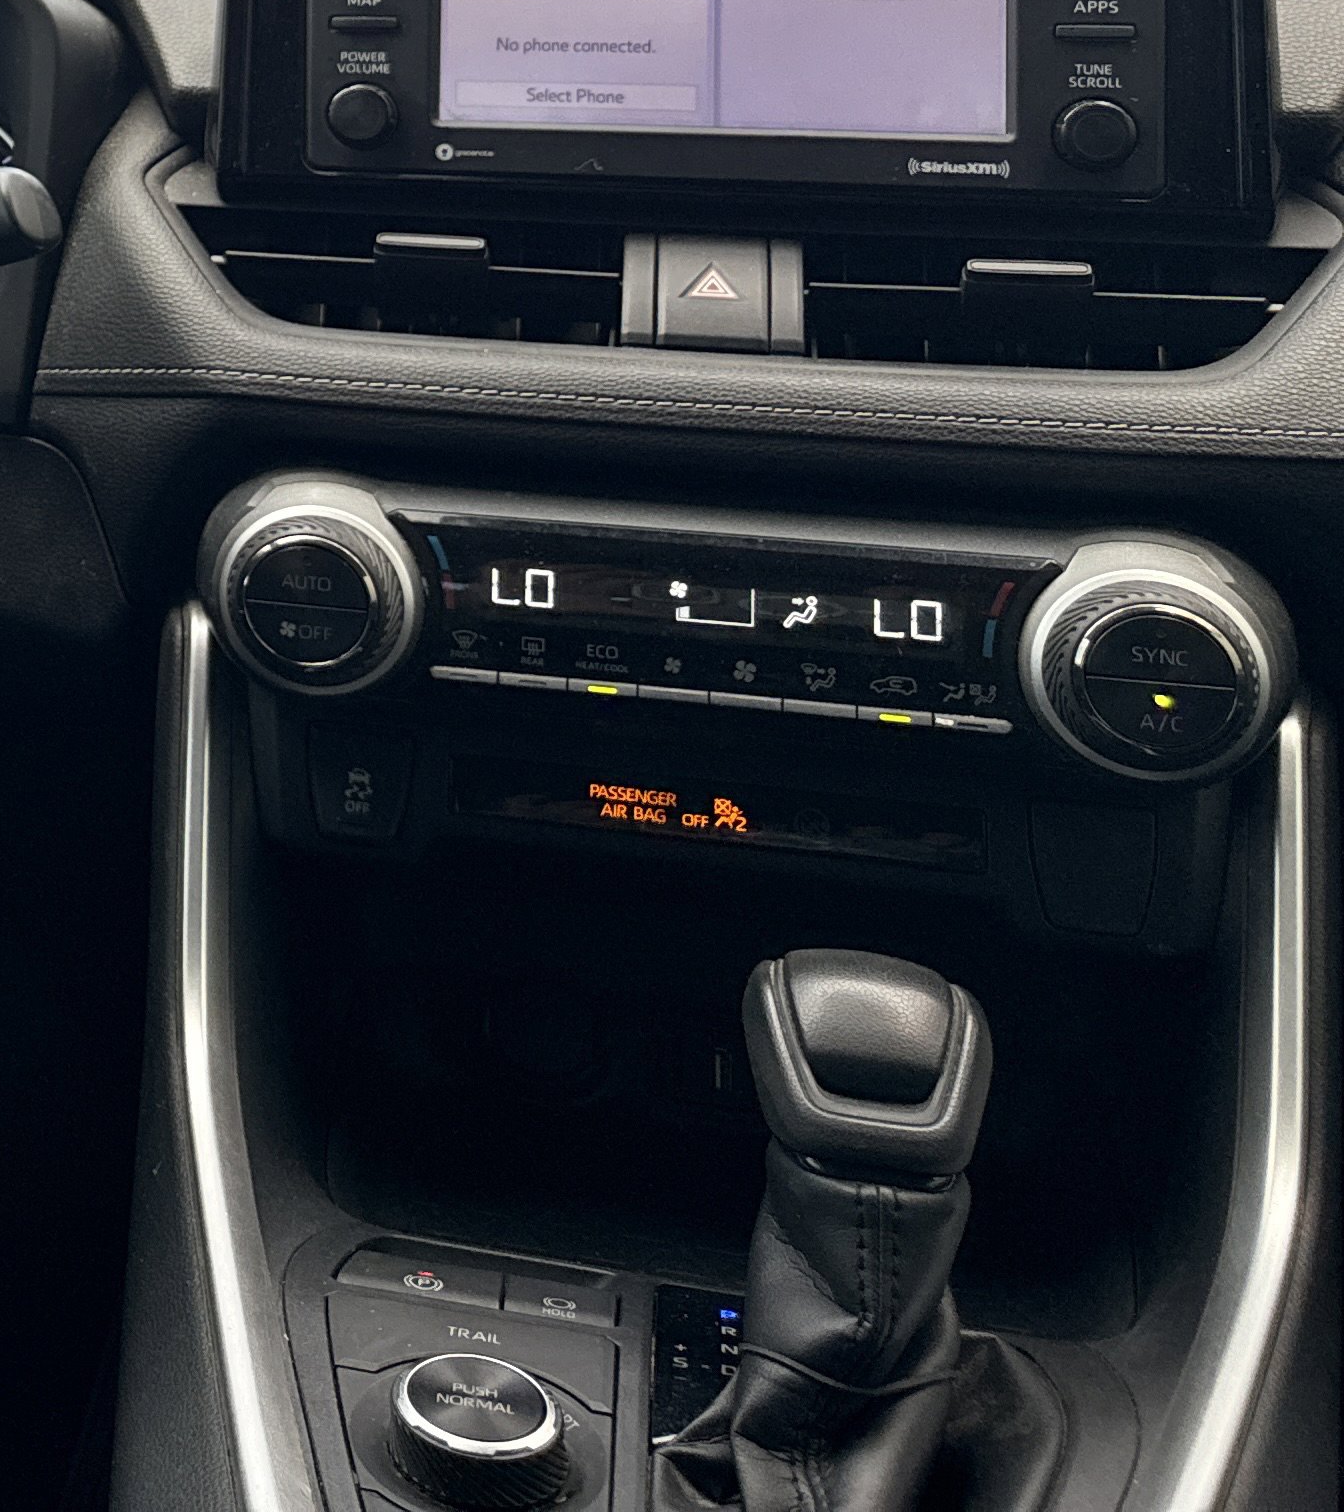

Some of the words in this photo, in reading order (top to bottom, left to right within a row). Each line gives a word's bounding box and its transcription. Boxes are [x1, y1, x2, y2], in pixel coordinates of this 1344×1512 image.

[1073, 0, 1119, 14] APPS
[496, 37, 519, 52] No
[523, 38, 569, 54] phone
[573, 39, 656, 54] connected.
[340, 51, 386, 62] POWER
[337, 63, 391, 74] VOLUME
[1074, 63, 1113, 76] TUNE
[1068, 76, 1123, 88] SCROLL
[526, 87, 572, 103] Select
[576, 88, 625, 104] Phone
[281, 574, 332, 592] AUTO
[491, 567, 555, 609] LO
[873, 598, 943, 642] LO
[298, 624, 332, 640] OFF
[586, 643, 619, 660] ECO
[1132, 646, 1189, 667] SYNC
[520, 656, 544, 667] REAR
[575, 660, 629, 674] HEAT/COOL
[1140, 713, 1184, 733] A/C
[589, 783, 677, 807] PASSENGER
[600, 803, 628, 819] AIR
[633, 806, 667, 824] BAG
[681, 813, 709, 828] OFF
[542, 1307, 576, 1319] HOLD
[447, 1325, 501, 1345] TRAIL
[452, 1382, 498, 1398] PUSH
[436, 1392, 515, 1415] NORMAL
